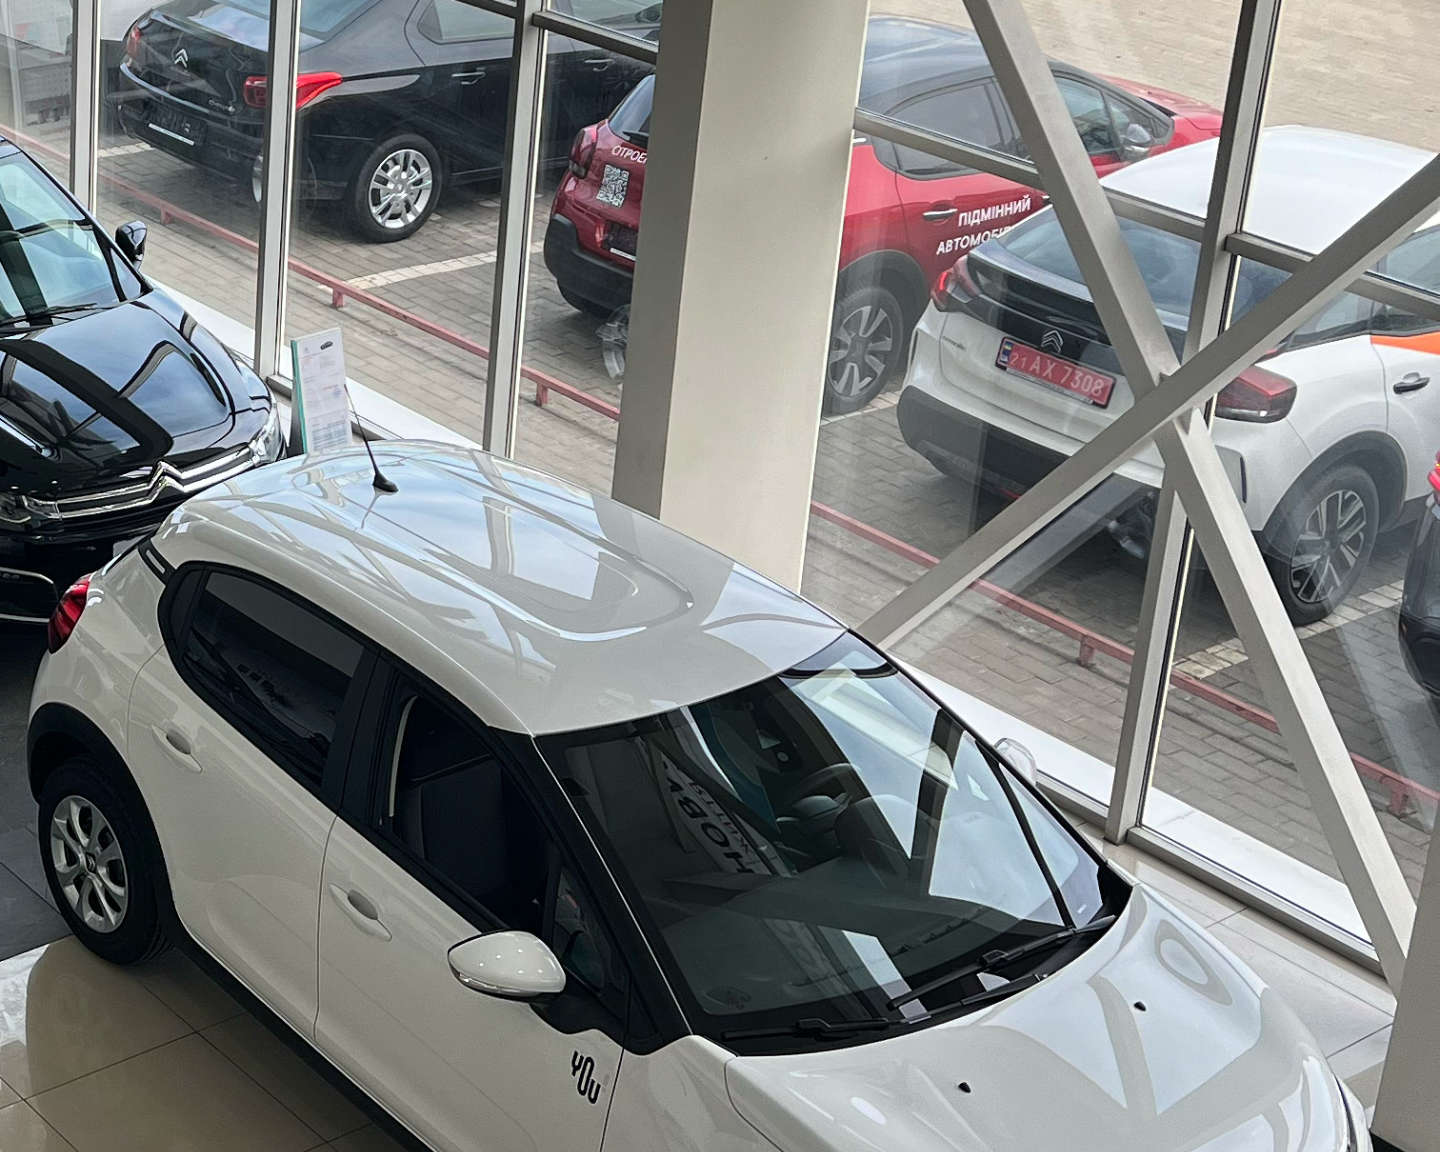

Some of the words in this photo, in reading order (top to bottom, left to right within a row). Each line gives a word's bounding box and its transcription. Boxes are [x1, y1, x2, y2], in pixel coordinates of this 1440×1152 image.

[958, 194, 1032, 227] ПІДМІННИЙ
[1029, 355, 1056, 381] AX
[1060, 366, 1105, 397] 7308
